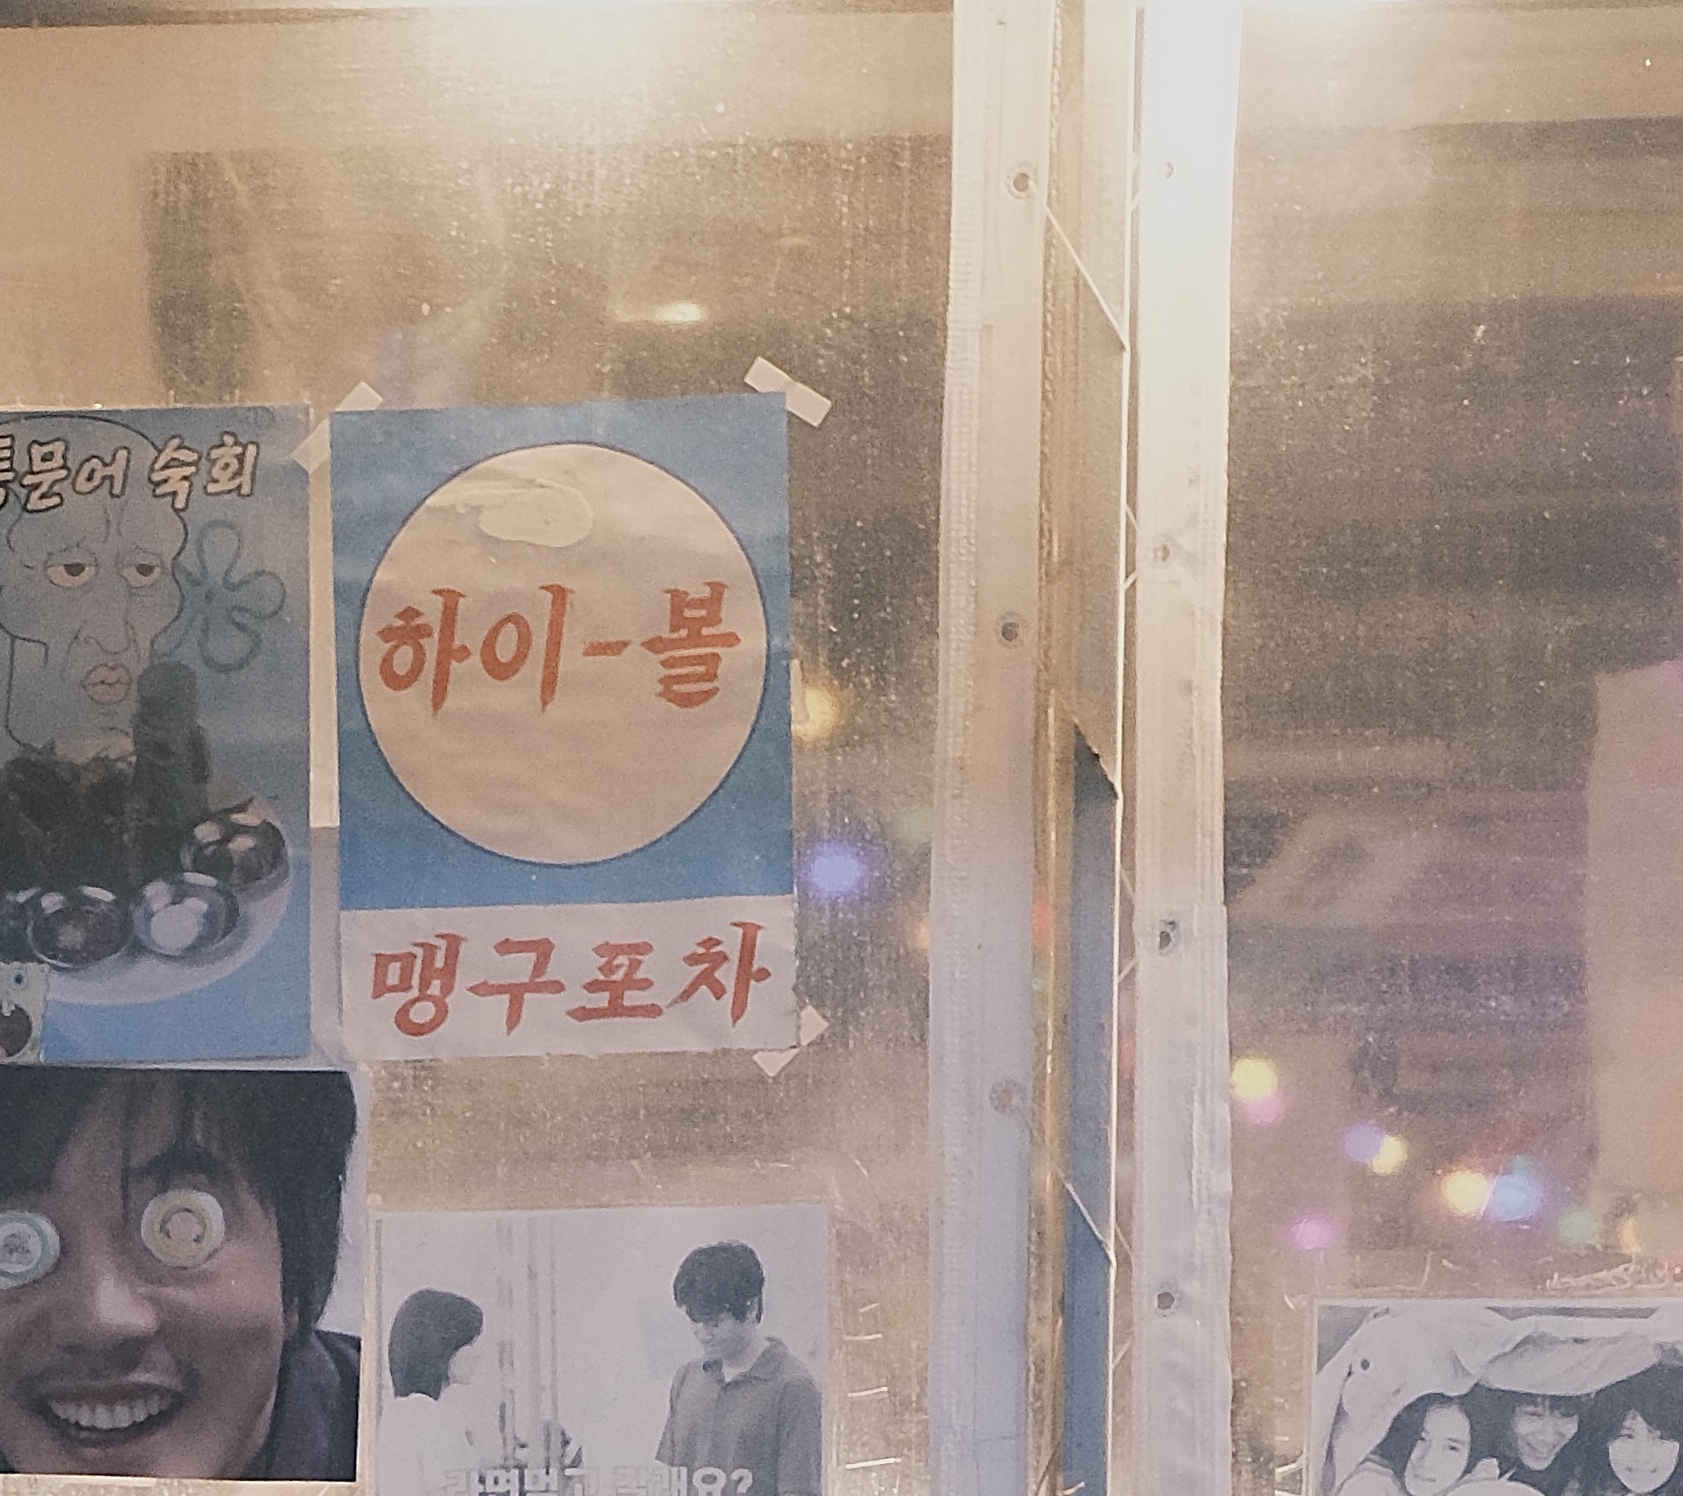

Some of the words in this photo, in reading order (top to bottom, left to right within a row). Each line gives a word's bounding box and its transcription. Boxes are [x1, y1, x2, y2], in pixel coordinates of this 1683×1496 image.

[149, 432, 261, 511] 숙회
[376, 582, 741, 714] 하이-볼
[370, 921, 771, 1037] 맹구포차
